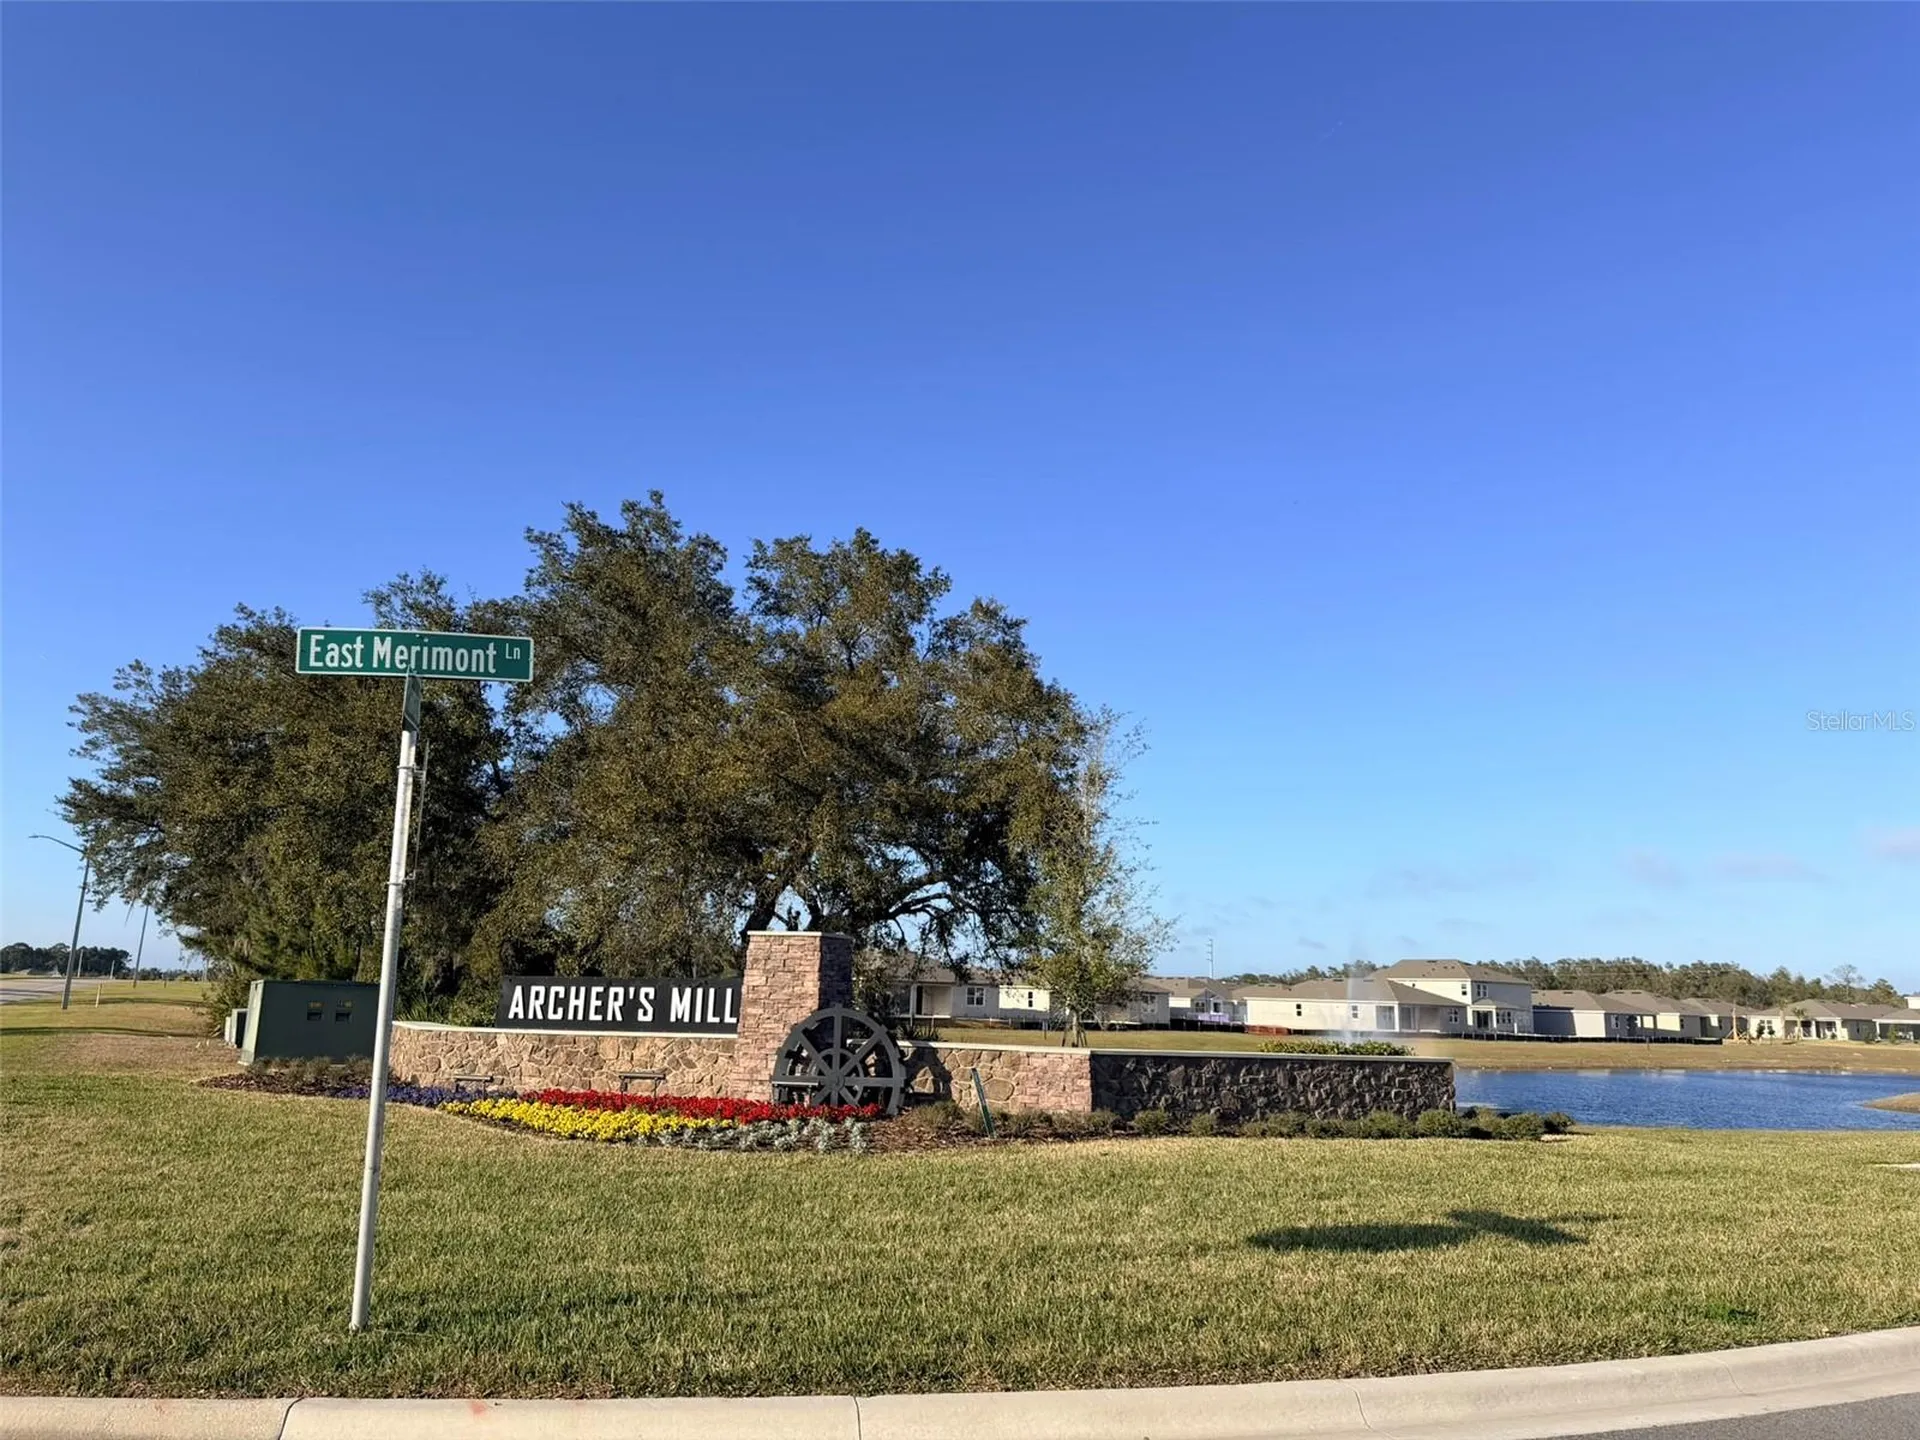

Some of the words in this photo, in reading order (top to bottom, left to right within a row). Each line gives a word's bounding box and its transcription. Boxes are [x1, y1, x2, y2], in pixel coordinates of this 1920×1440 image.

[309, 634, 364, 668] East
[372, 636, 497, 674] Merimont
[505, 643, 521, 660] Ln
[508, 985, 655, 1021] ARCHER'S
[669, 987, 737, 1023] MILL
